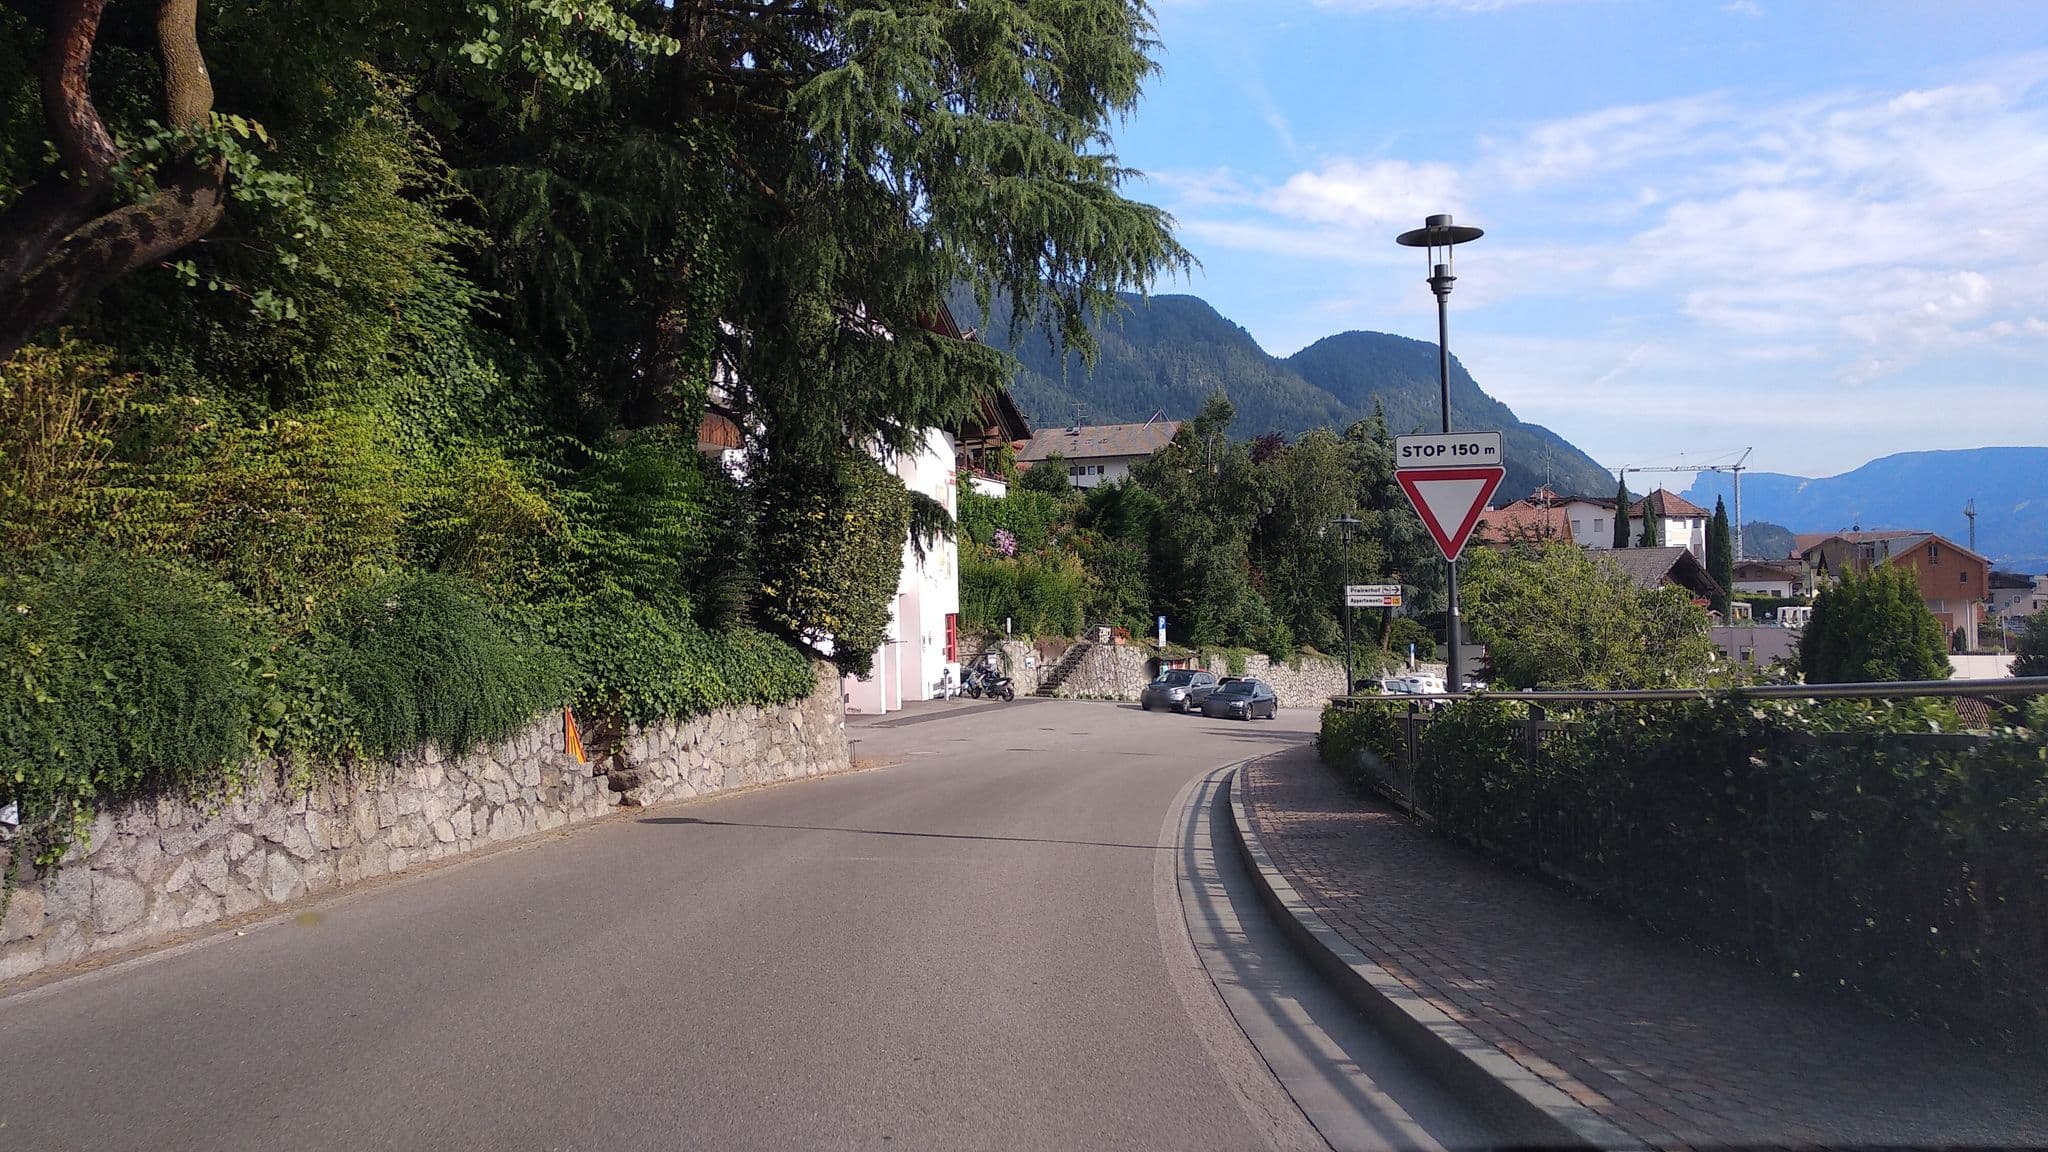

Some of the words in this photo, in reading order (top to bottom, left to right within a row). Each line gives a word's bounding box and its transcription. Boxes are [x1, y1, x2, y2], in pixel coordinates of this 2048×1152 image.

[1402, 445, 1446, 457] STOP
[1451, 443, 1479, 456] 150
[1484, 446, 1496, 455] m
